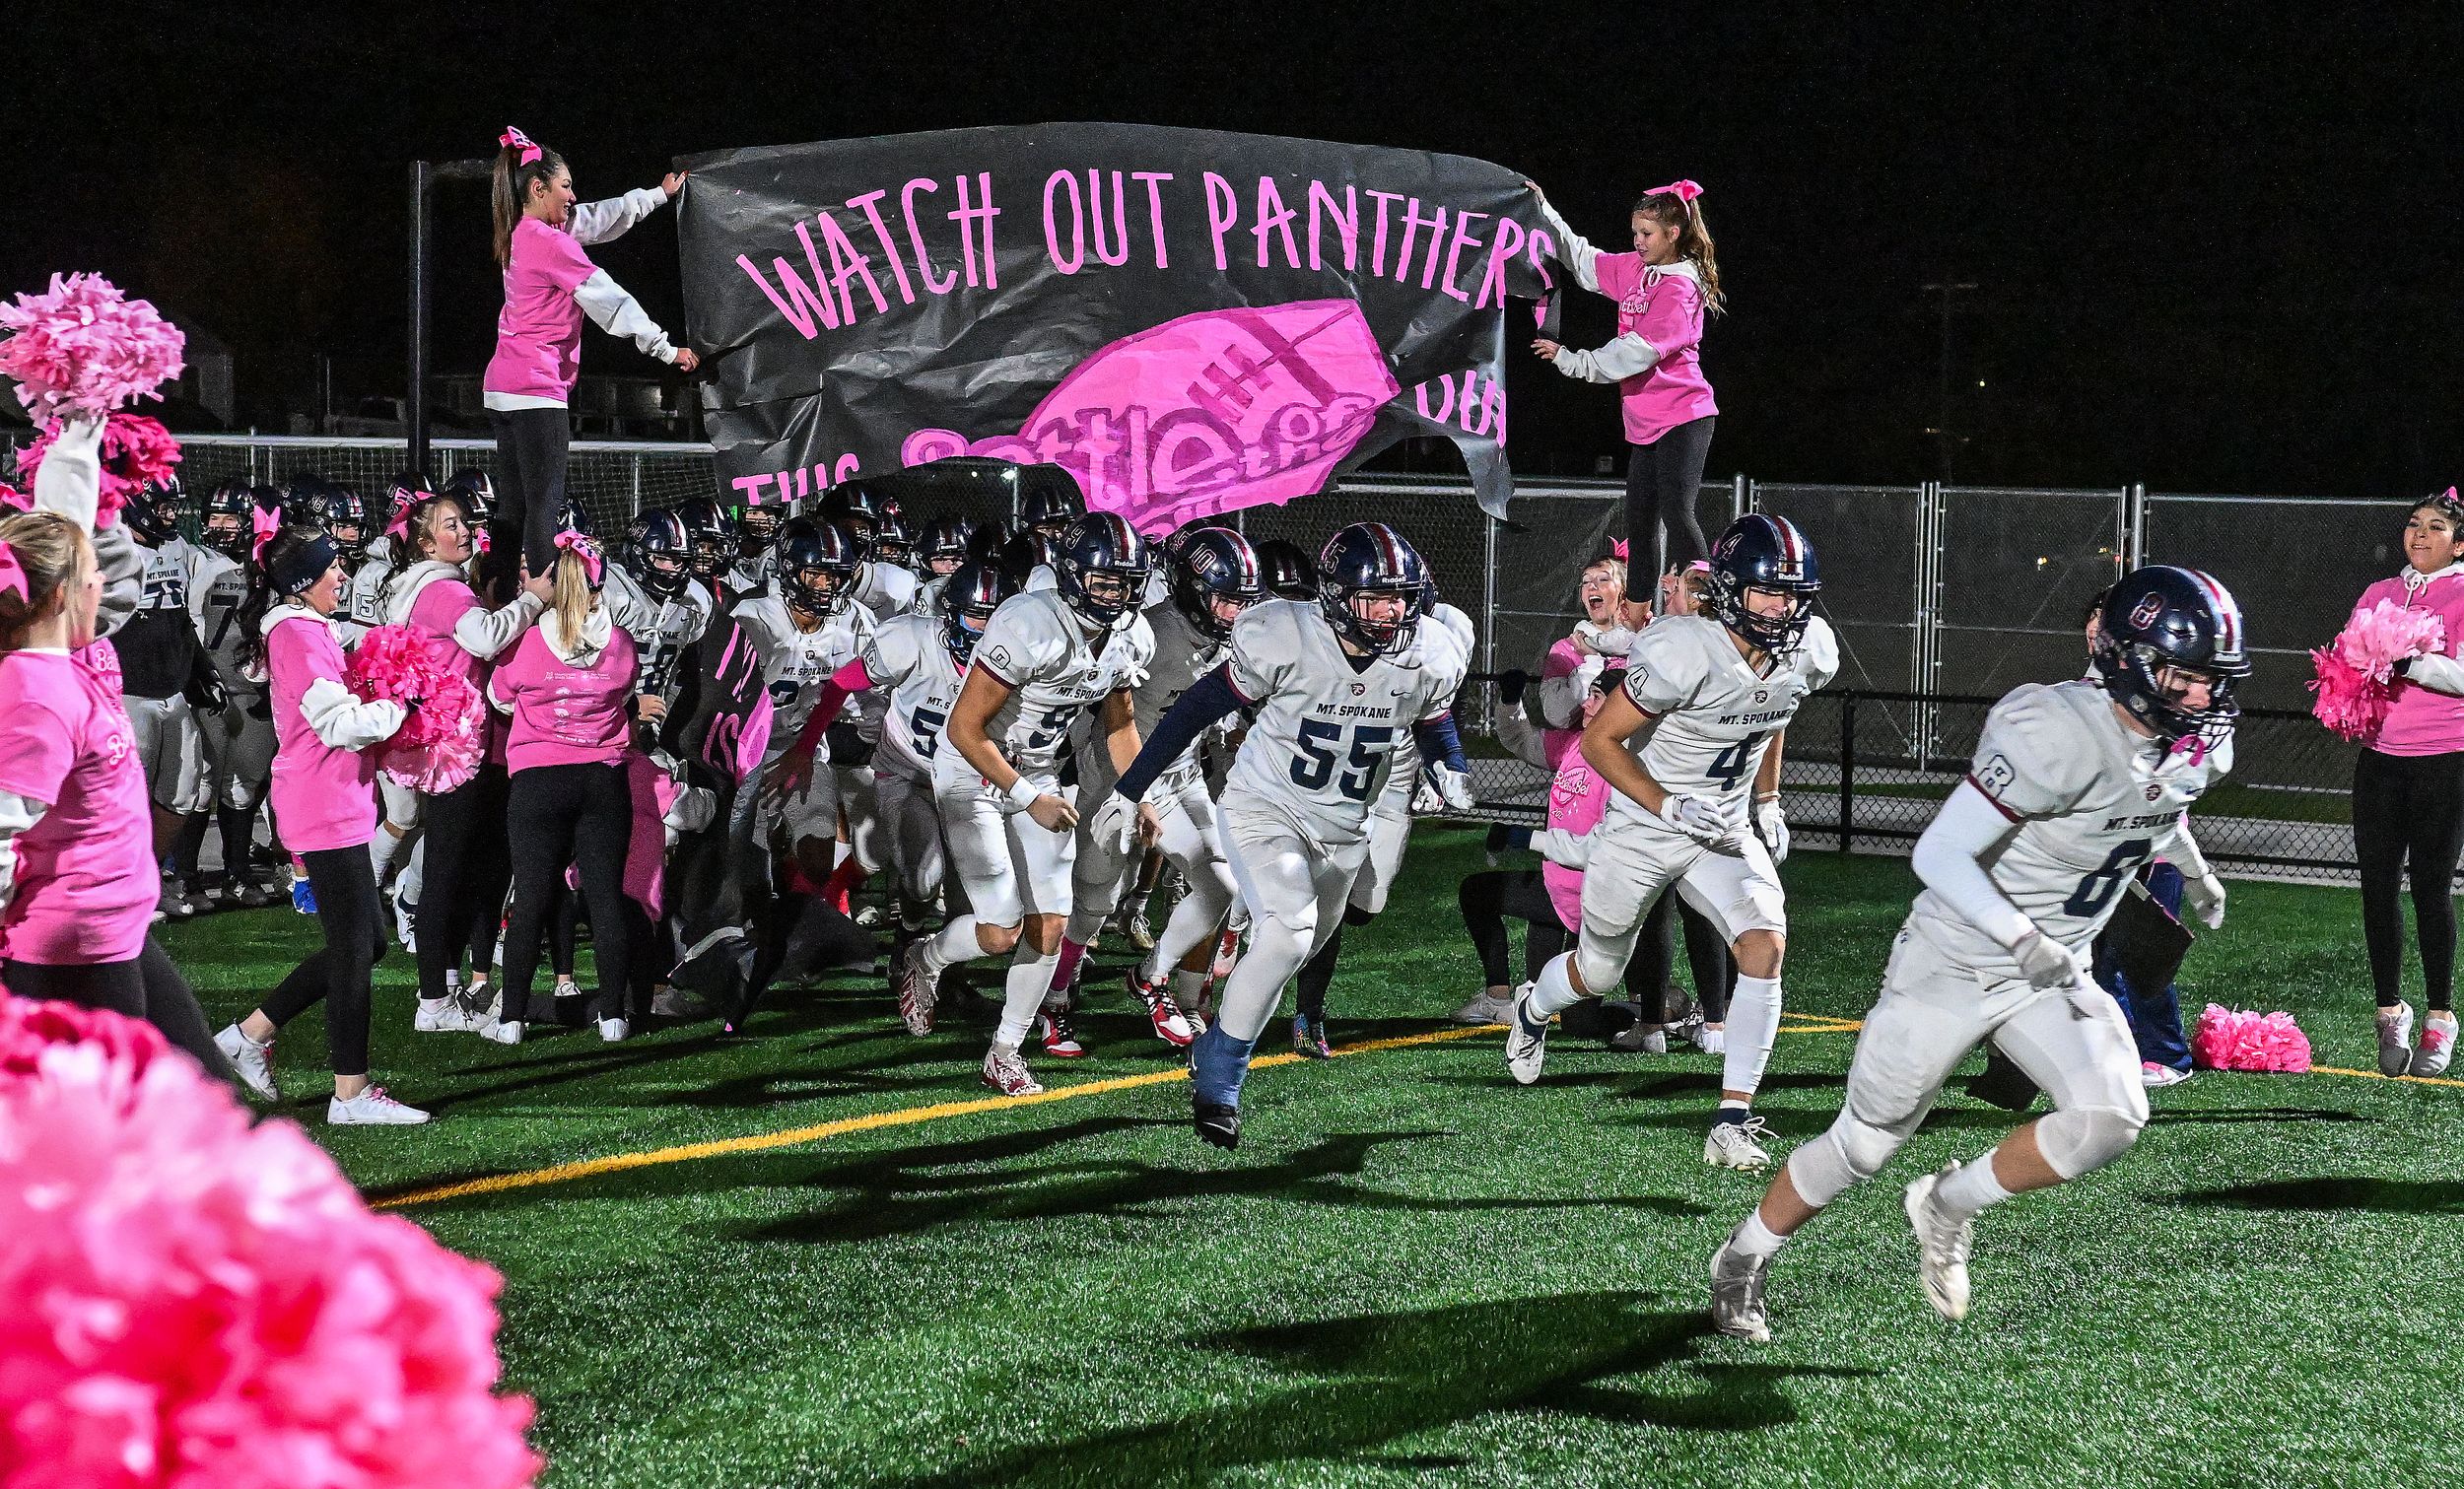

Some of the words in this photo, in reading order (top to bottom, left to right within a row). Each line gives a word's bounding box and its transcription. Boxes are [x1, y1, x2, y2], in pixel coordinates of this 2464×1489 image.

[736, 172, 1001, 340] WATCH
[1043, 169, 1174, 275] OUT
[1202, 170, 1556, 311] PANTHERS
[1189, 543, 1217, 575] 10
[355, 592, 376, 619] 15
[2129, 591, 2166, 631] 8
[782, 667, 796, 676] MT.
[798, 666, 834, 676] SPOKANE
[1628, 666, 1650, 699] 4
[1056, 687, 1073, 698] MT.
[1316, 703, 1336, 715] MT.
[1338, 705, 1393, 719] SPOKANE
[1718, 714, 1740, 725] MT.
[1742, 709, 1791, 725] SPOKANE
[1289, 717, 1395, 802] 55
[1705, 730, 1768, 792] 4
[1976, 754, 2017, 799] 8
